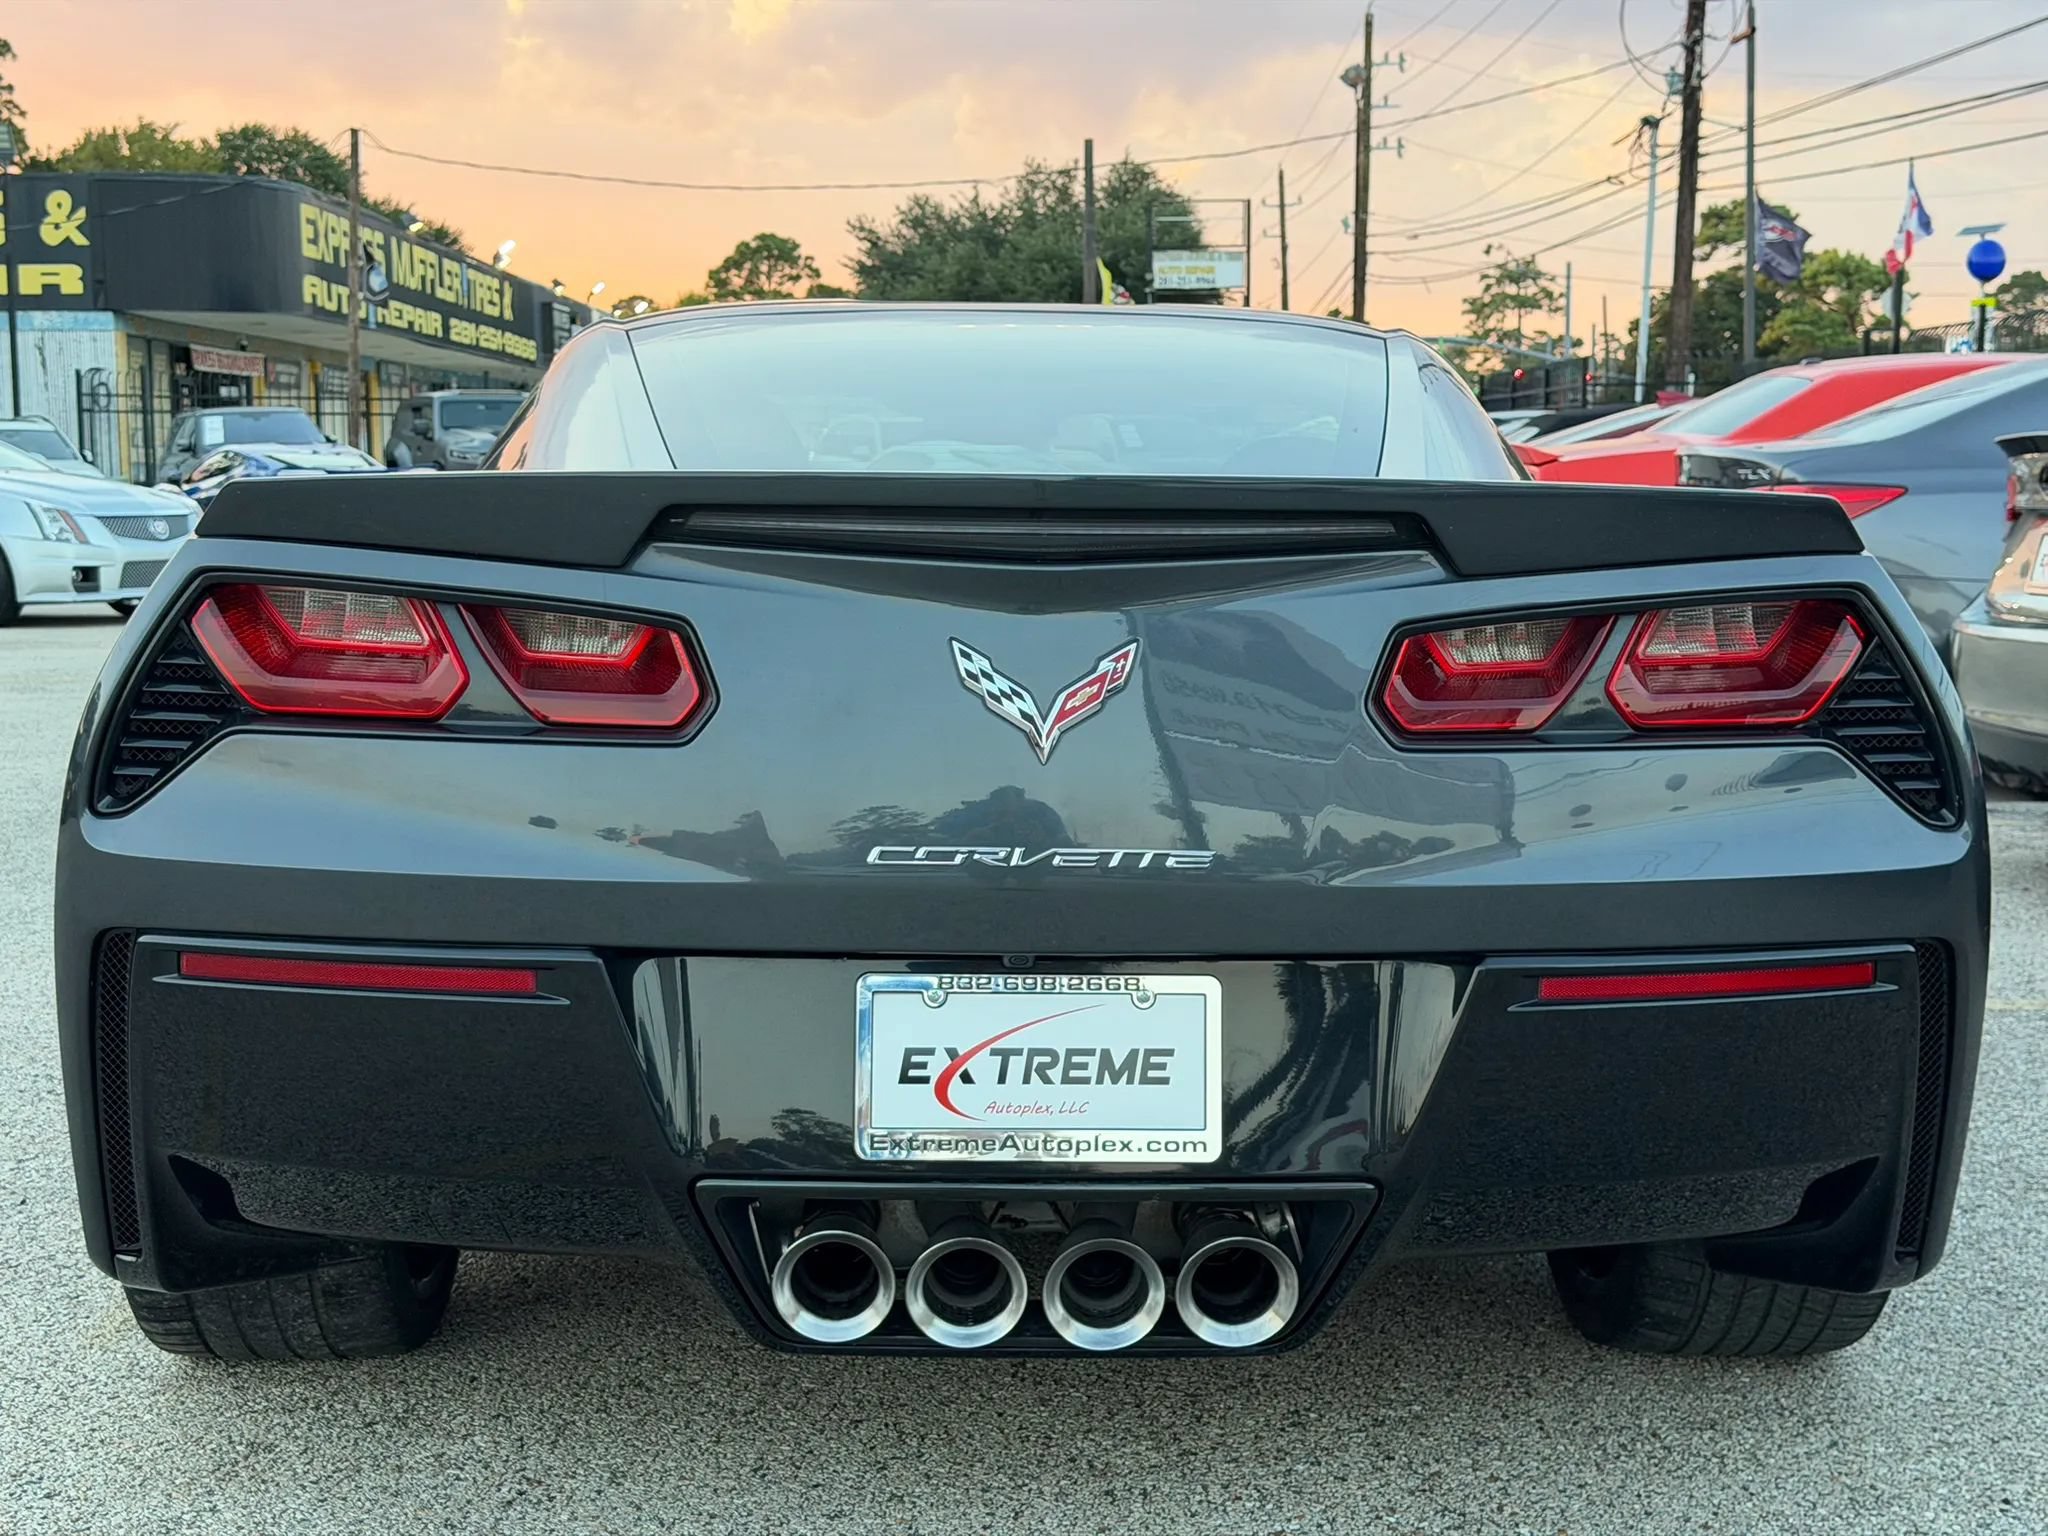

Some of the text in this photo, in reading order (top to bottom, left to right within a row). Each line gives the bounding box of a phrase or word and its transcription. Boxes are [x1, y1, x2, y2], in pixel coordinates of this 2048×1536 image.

[39, 189, 91, 246] &
[377, 299, 443, 338] REPAIR
[866, 846, 1216, 868] CORVETTE
[898, 1047, 1175, 1085] EXTREME
[1058, 1101, 1090, 1114] LLC
[870, 1133, 1207, 1156] ExtremeAutoplex.com
